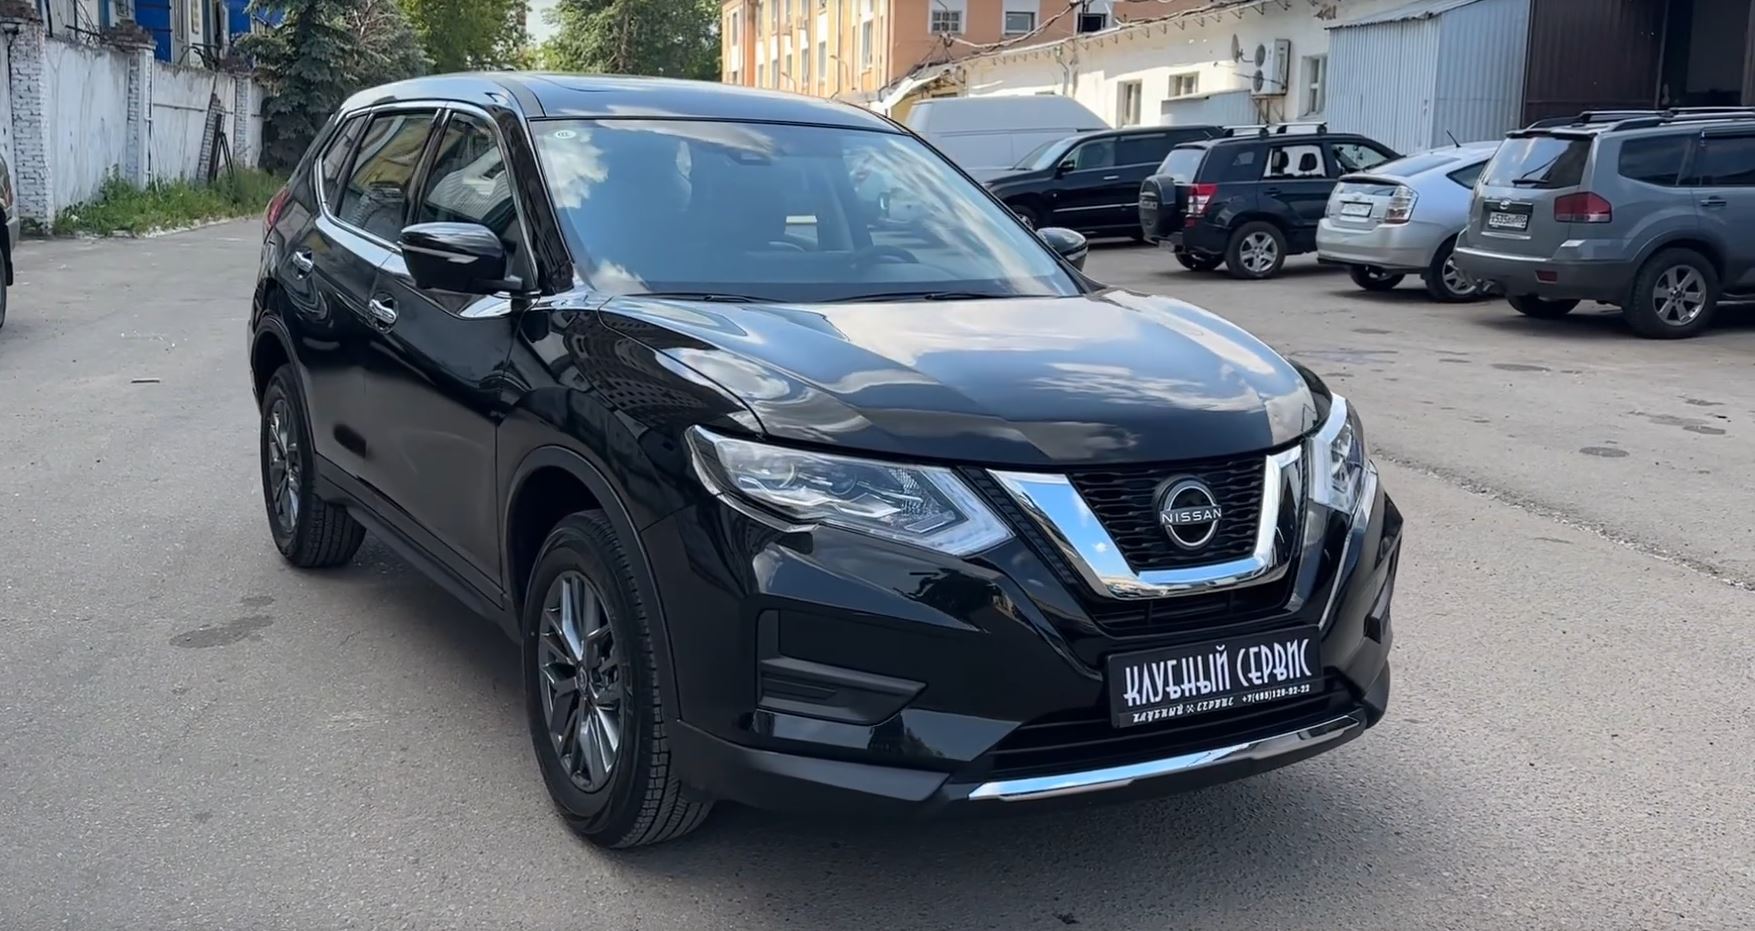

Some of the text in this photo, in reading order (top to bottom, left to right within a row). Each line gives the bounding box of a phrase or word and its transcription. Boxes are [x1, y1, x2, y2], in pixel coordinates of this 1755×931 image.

[1161, 507, 1222, 524] NISSAN
[1123, 638, 1312, 707] КЛУБНЫЙ СЕРВИС
[1196, 696, 1235, 712] СЕРВИС
